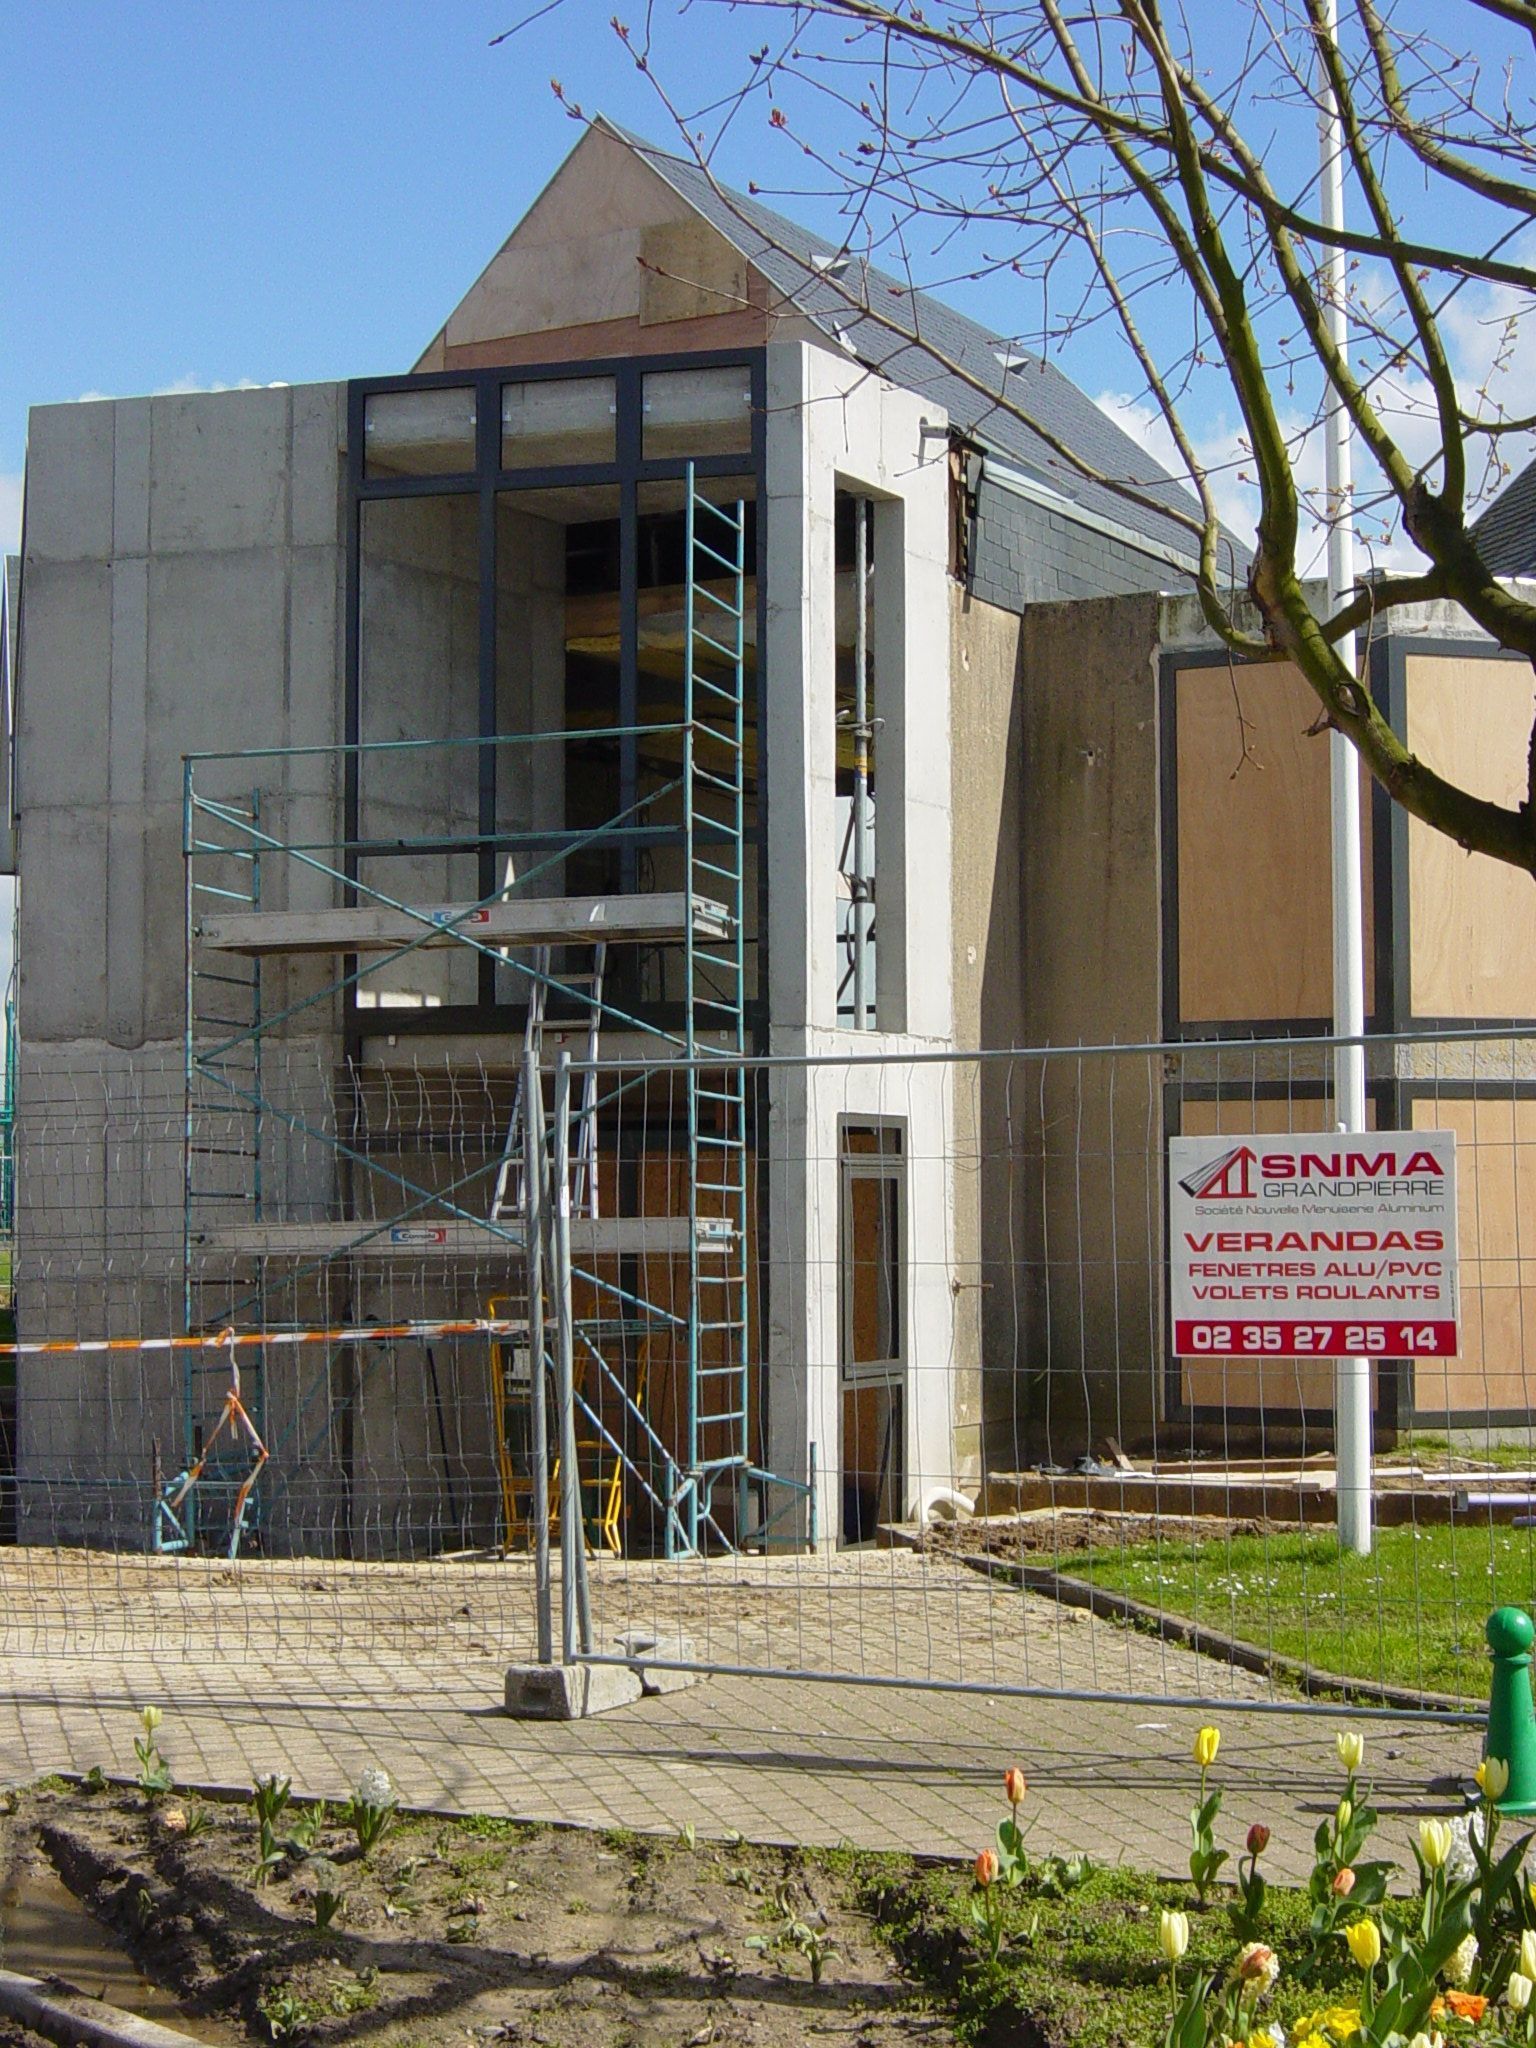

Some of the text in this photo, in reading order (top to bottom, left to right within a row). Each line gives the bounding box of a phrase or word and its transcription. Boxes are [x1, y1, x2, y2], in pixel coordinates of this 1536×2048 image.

[1261, 1152, 1444, 1178] SNMA
[1263, 1180, 1444, 1198] GRANDPIERRE
[1195, 1205, 1243, 1215] Société
[1184, 1231, 1444, 1252] VERANDAS
[1189, 1259, 1442, 1279] FENETRES ALU/PVC
[1192, 1284, 1440, 1299] VOLETS ROULANTS
[1192, 1325, 1438, 1351] 02 35 27 25 14
